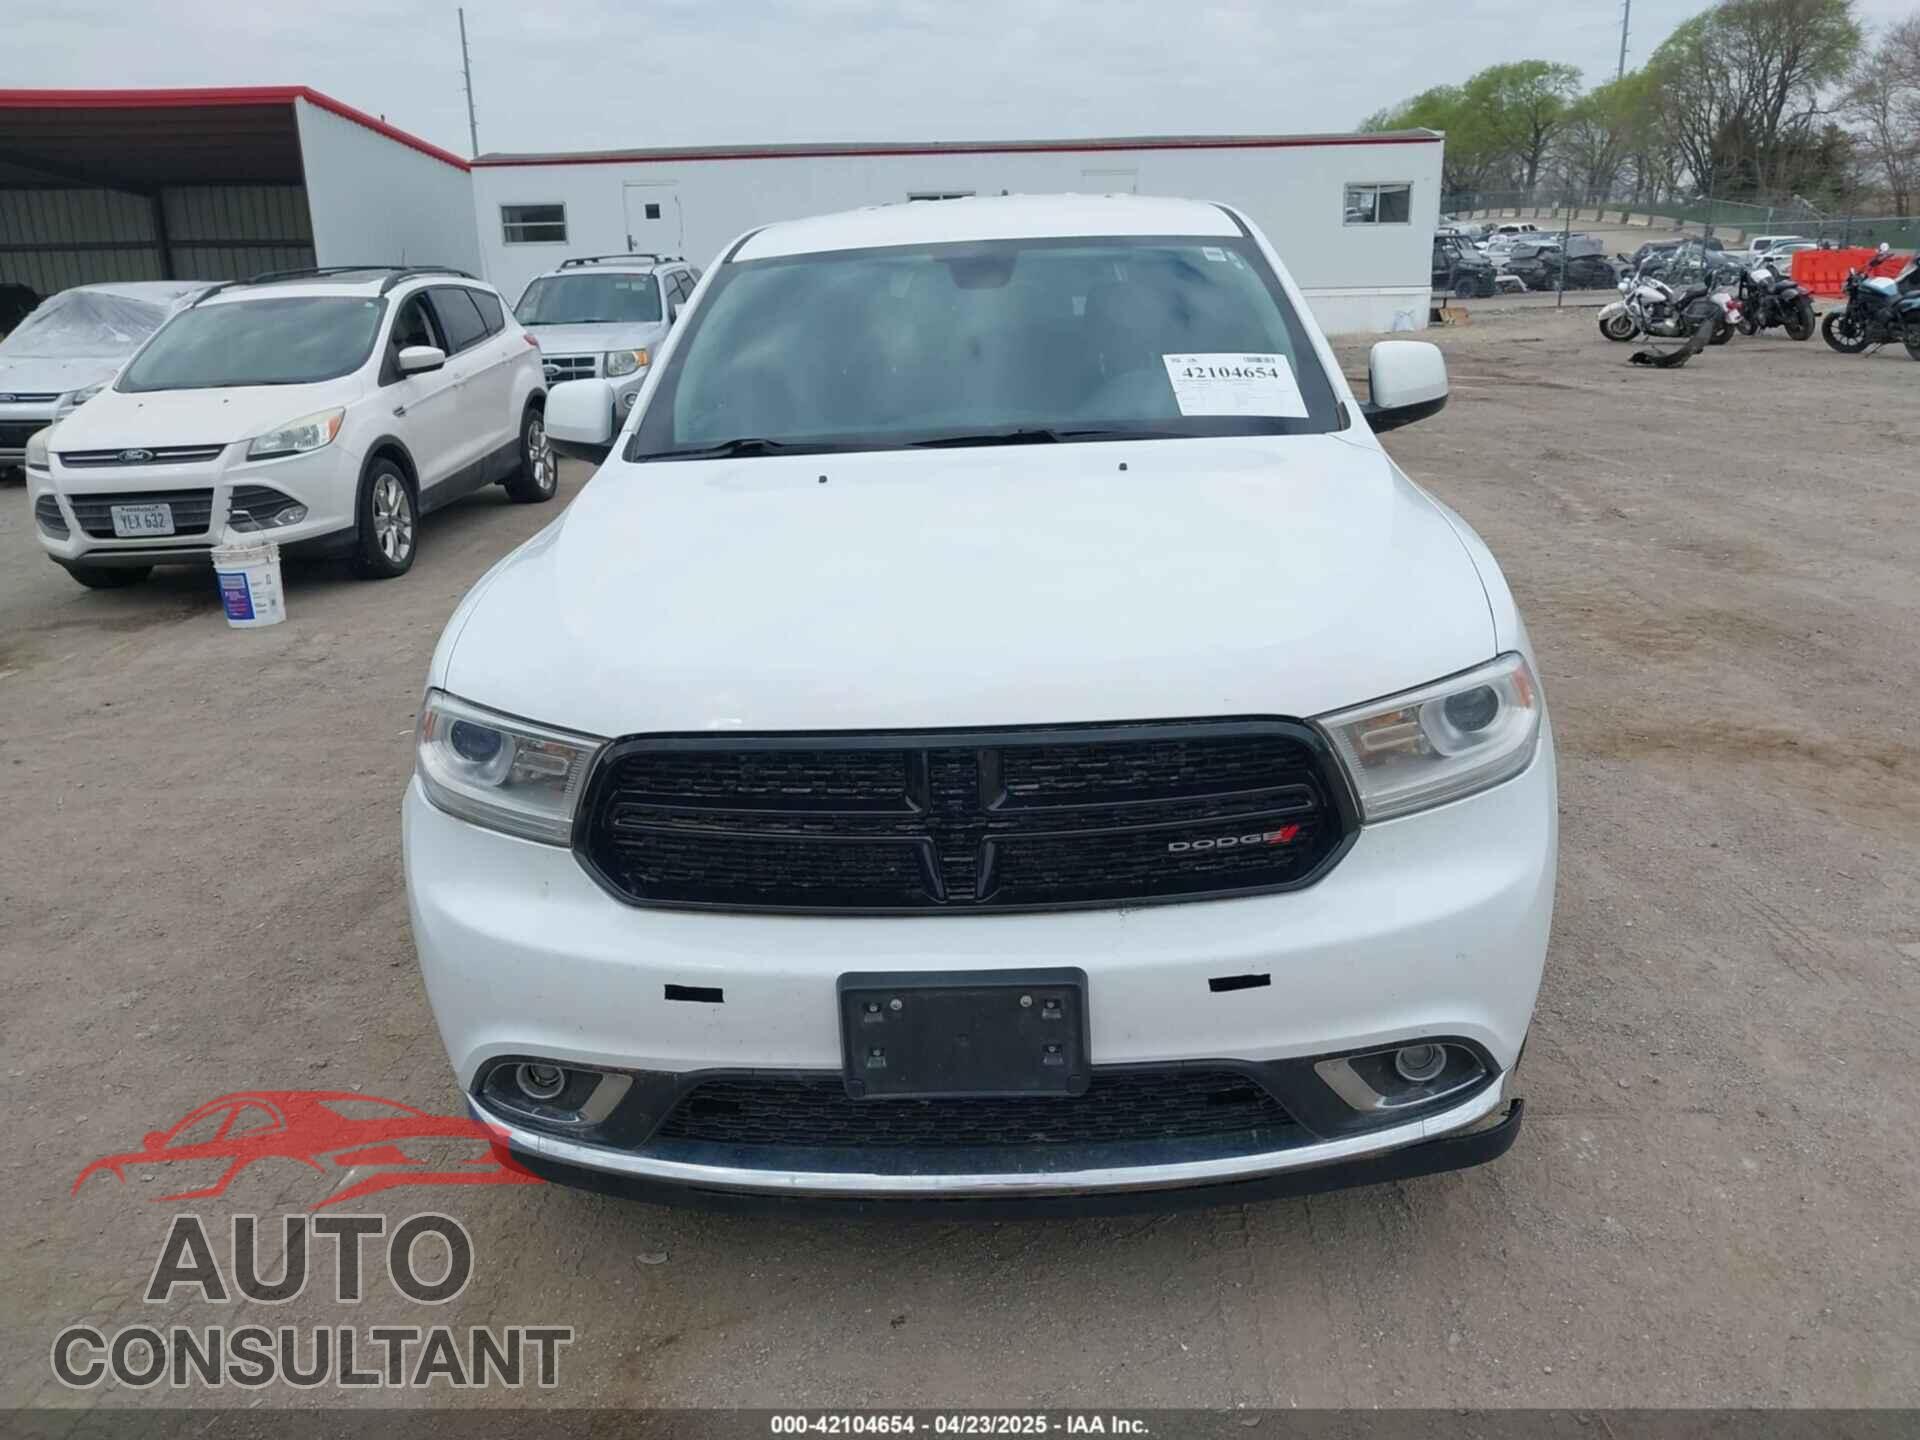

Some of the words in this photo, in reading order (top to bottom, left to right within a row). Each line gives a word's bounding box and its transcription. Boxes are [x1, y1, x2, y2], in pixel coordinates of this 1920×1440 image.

[1182, 367, 1279, 379] 42104654
[145, 511, 166, 529] 632
[1168, 831, 1282, 851] DODGE
